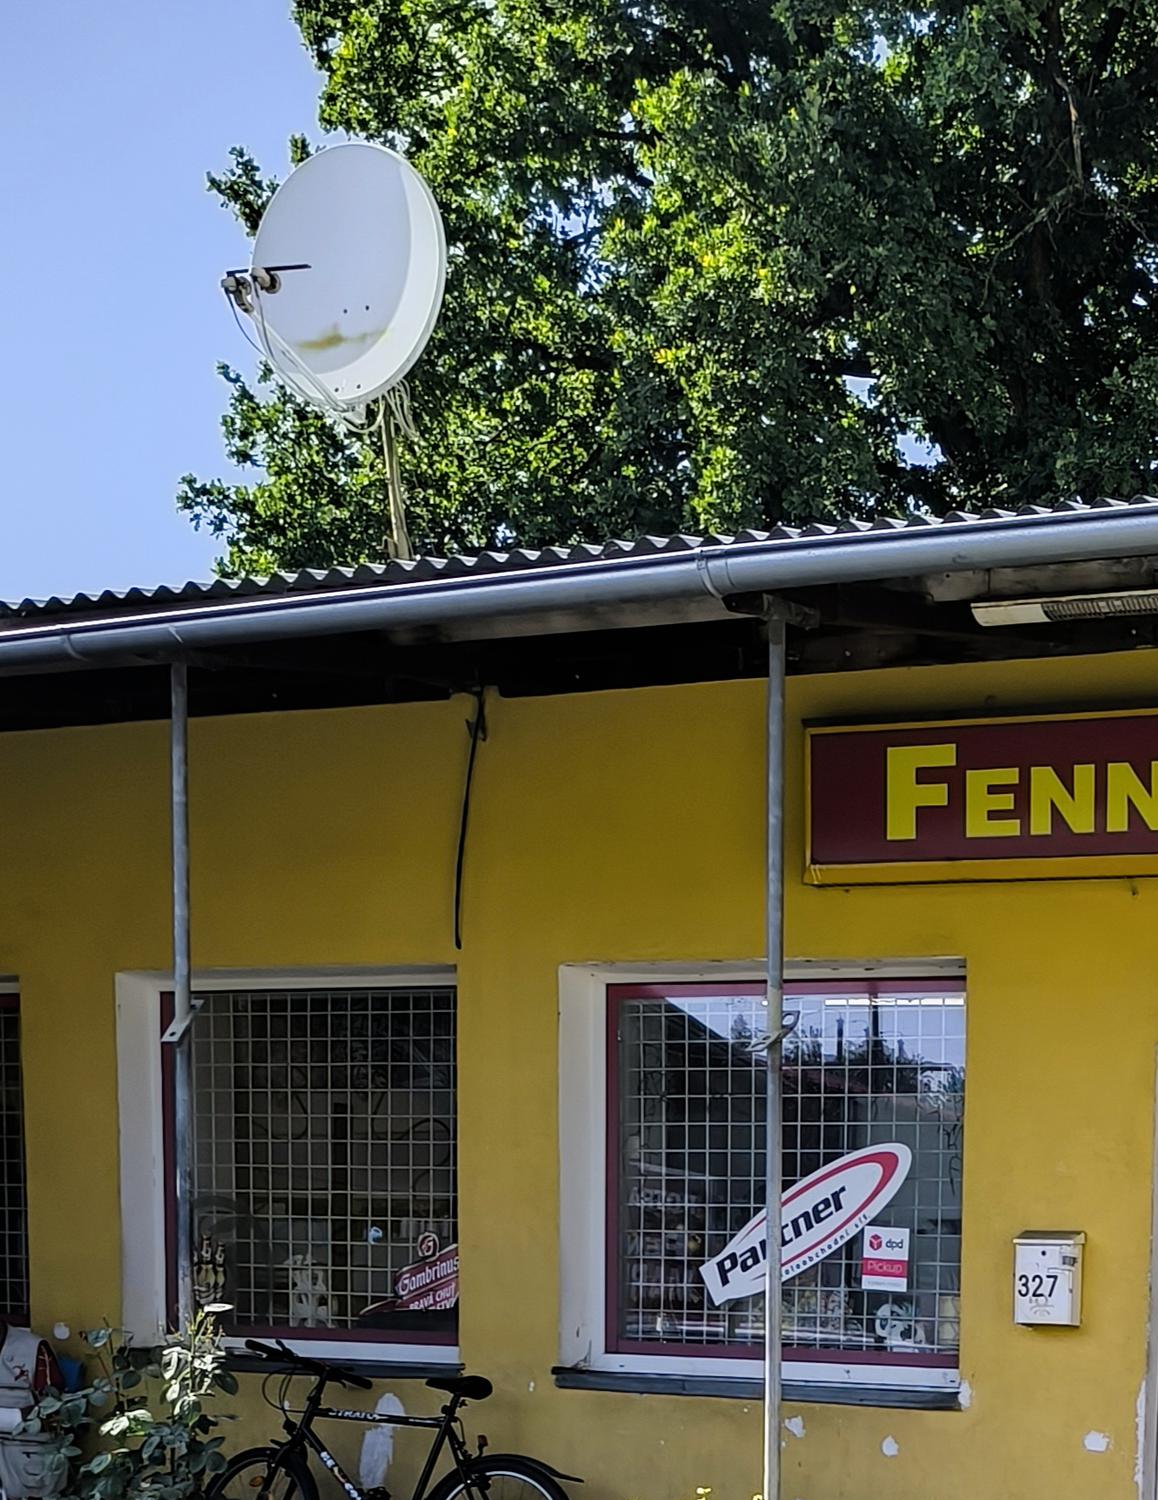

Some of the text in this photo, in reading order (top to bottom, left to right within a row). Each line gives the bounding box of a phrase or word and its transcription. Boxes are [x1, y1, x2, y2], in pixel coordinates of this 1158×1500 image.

[885, 1238, 904, 1251] dpd
[398, 1256, 460, 1296] Gambrinus
[1018, 1274, 1059, 1298] 327
